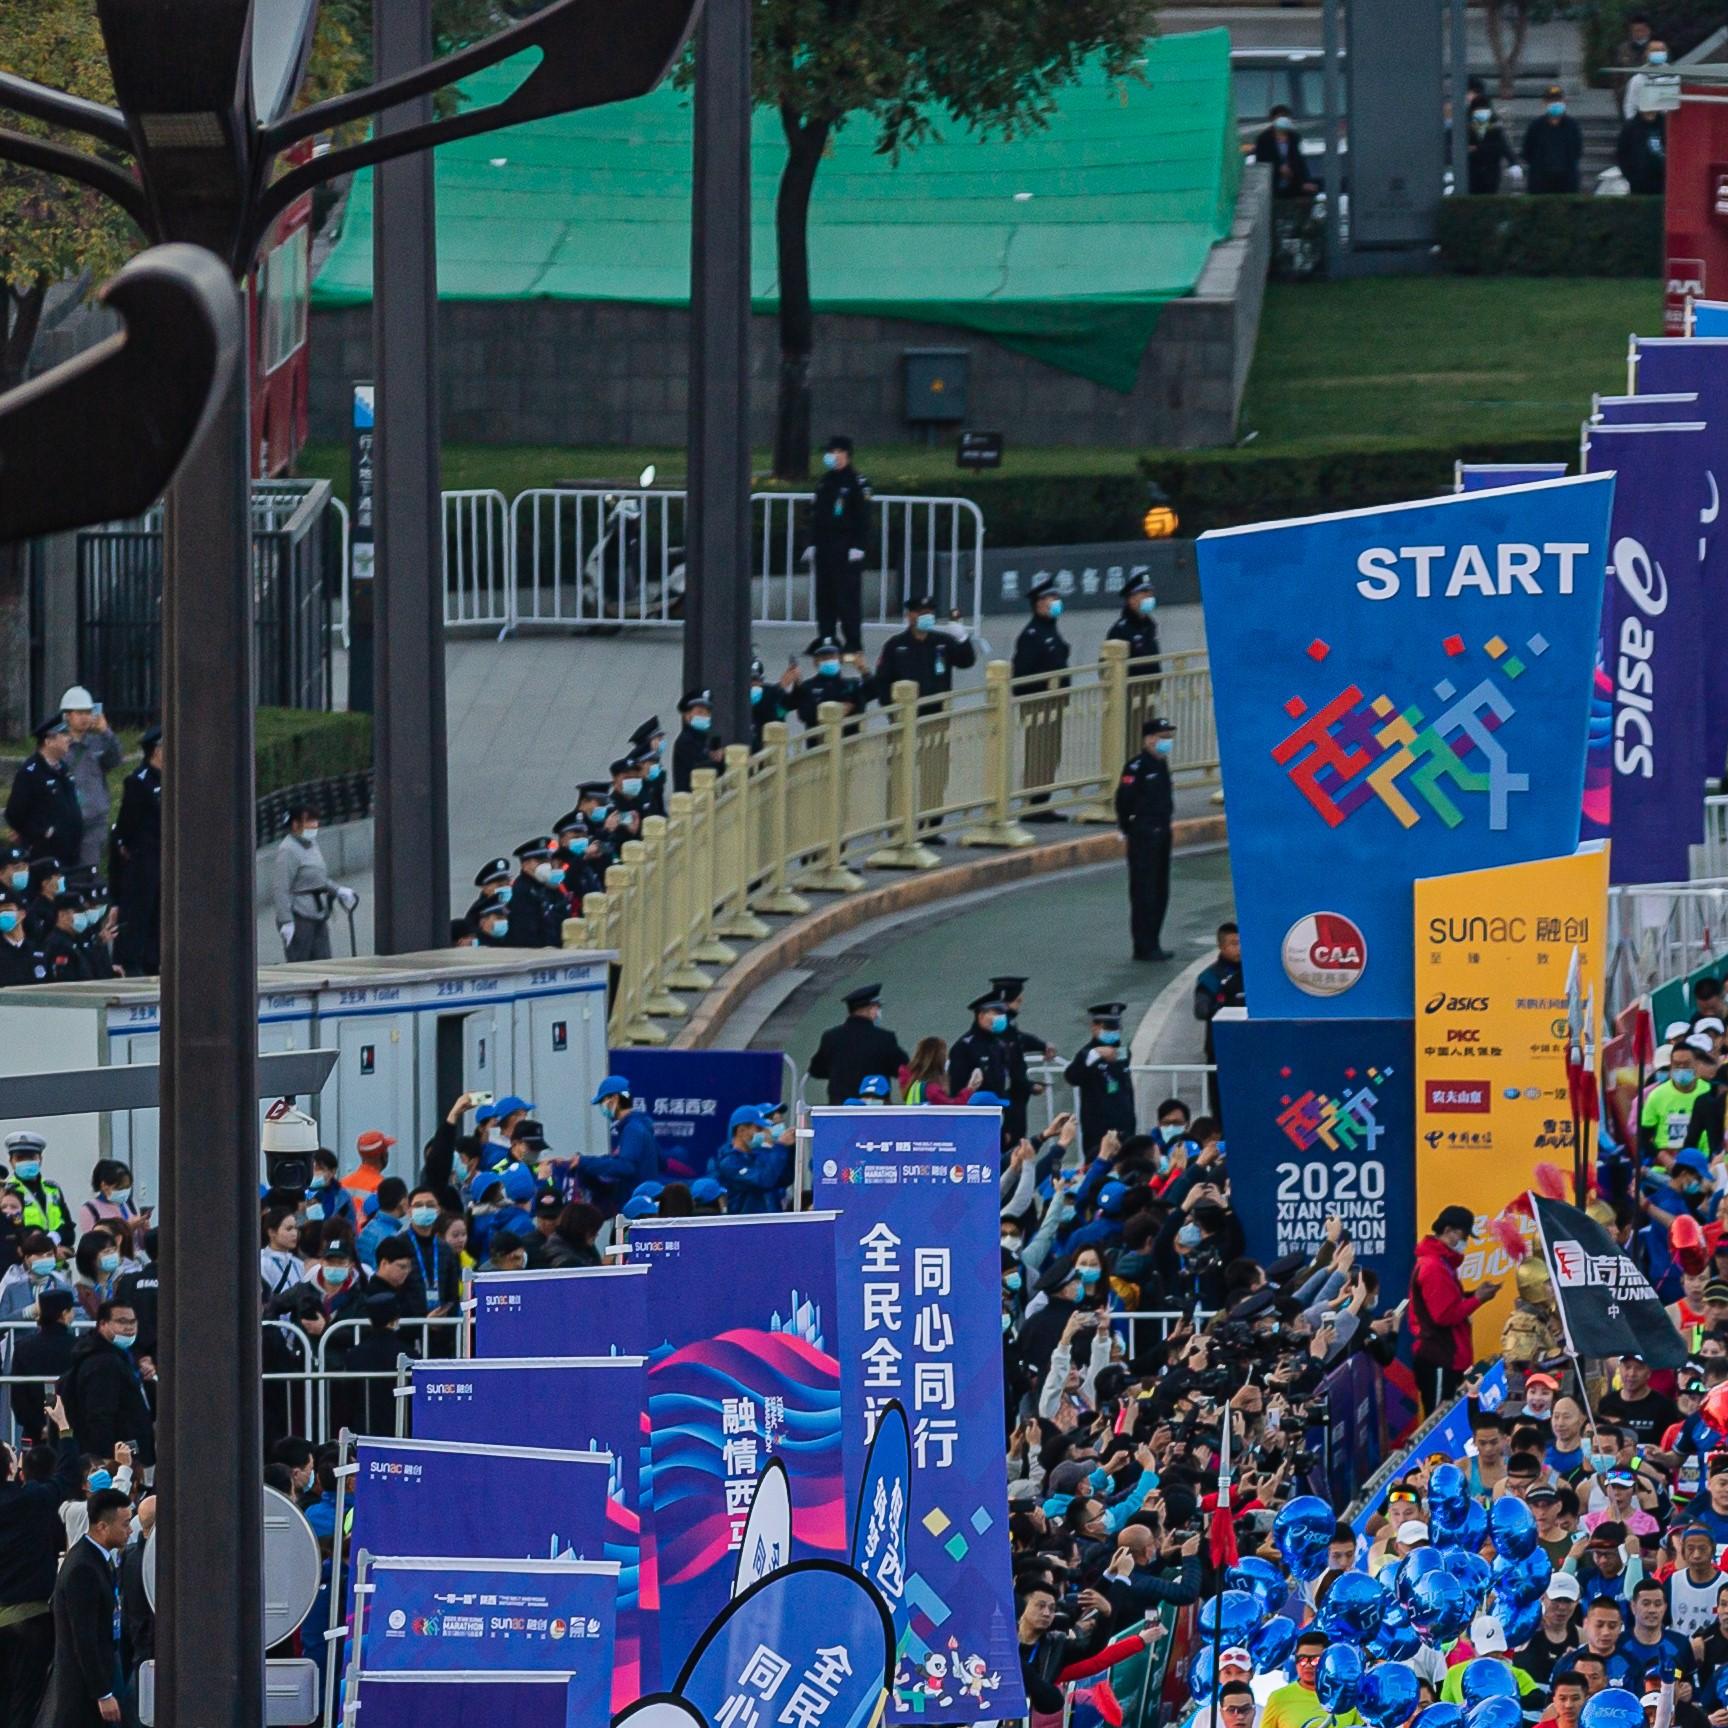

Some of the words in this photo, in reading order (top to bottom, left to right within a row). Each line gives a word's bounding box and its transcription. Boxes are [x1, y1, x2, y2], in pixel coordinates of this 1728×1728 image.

[1357, 543, 1588, 599] START
[1614, 630, 1655, 778] asics
[1429, 917, 1526, 944] sunac
[1536, 917, 1590, 944] 融创
[1314, 946, 1360, 963] CAA
[1446, 997, 1490, 1012] asics
[1447, 1029, 1481, 1043] PICC
[653, 1098, 717, 1115] 乐活西安
[1432, 1090, 1483, 1104] 农夫山泉
[1276, 1161, 1385, 1200] 2020
[1325, 1200, 1385, 1219] SUNAC
[1277, 1220, 1386, 1241] MARAHON
[1608, 1304, 1620, 1319] 中
[913, 1247, 960, 1469] 同心同行
